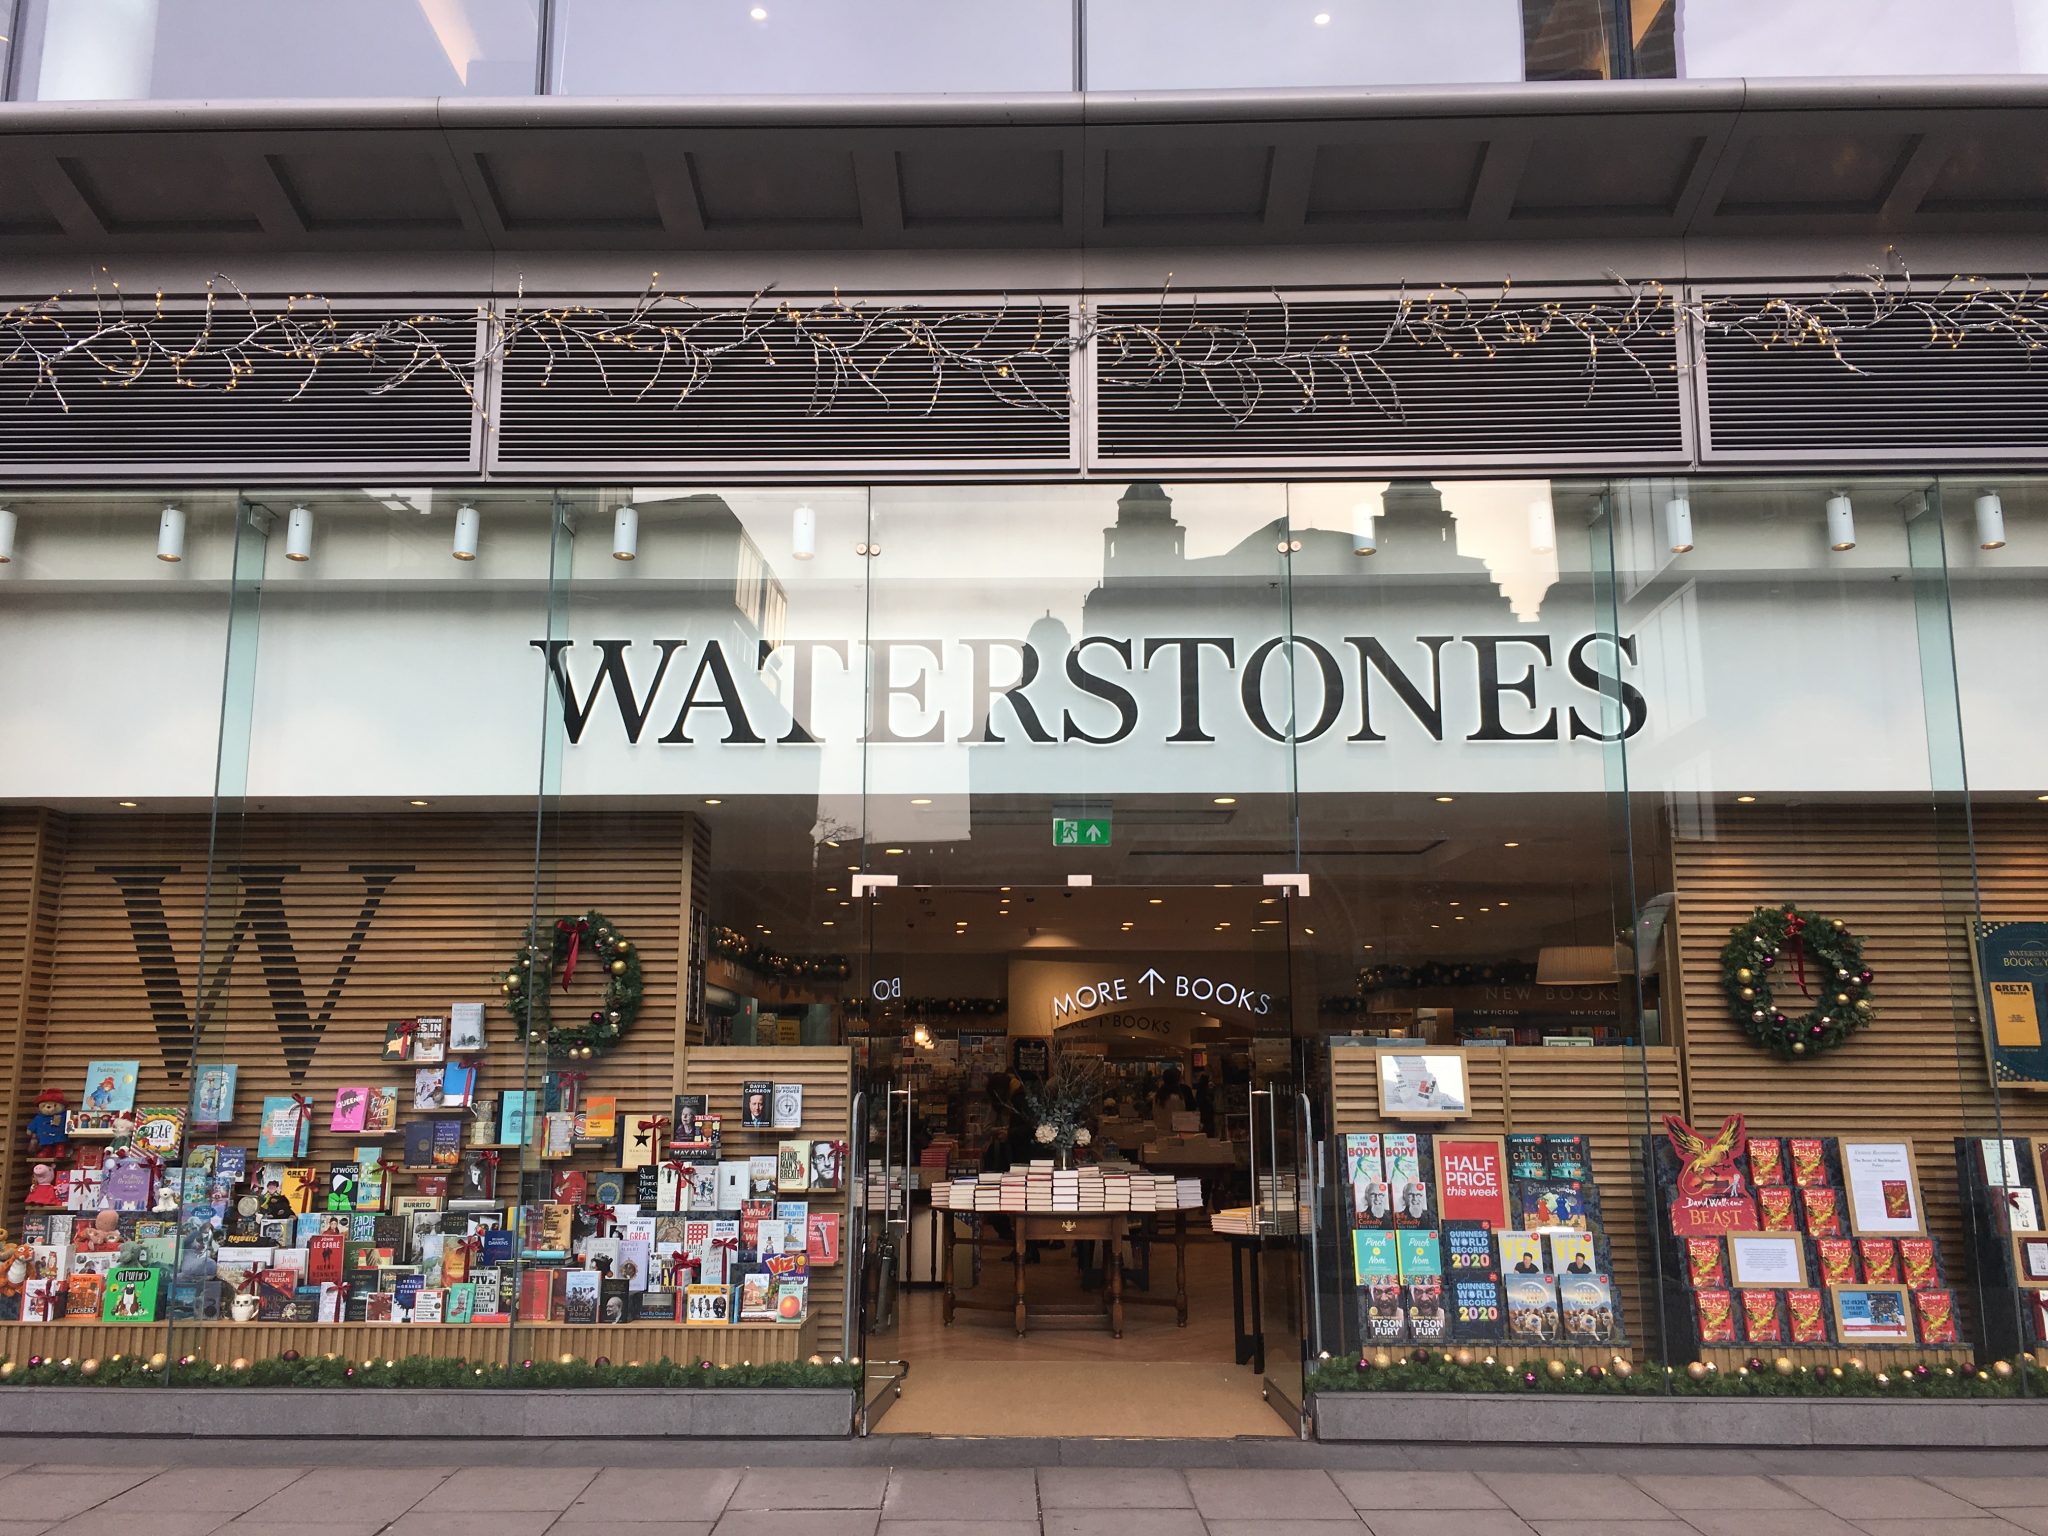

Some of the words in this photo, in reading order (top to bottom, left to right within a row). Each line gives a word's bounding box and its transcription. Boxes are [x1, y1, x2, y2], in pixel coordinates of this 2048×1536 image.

[530, 633, 1648, 745] WATERSTONES
[2004, 958, 2033, 966] BOOK
[1054, 978, 1128, 1017] MORE
[1175, 975, 1271, 1015] BOOKS
[336, 1094, 365, 1109] QUEENIE
[780, 1152, 798, 1161] BLIND
[1348, 1147, 1378, 1157] BODY
[1385, 1147, 1415, 1157] BODY
[1513, 1152, 1543, 1160] CHILD
[1551, 1152, 1581, 1160] CHILD
[1750, 1147, 1778, 1157] BEAST
[1793, 1147, 1821, 1157] BEAST
[780, 1161, 799, 1170] MAN'S
[1444, 1156, 1494, 1171] HALF
[780, 1170, 800, 1178] BREXIT
[1445, 1172, 1496, 1187] PRICE
[1446, 1186, 1467, 1196] this
[1469, 1186, 1498, 1197] week
[1682, 1197, 1709, 1208] David
[1709, 1197, 1743, 1208] Walliams
[1762, 1196, 1790, 1205] BEAST
[1805, 1196, 1833, 1206] BEAST
[747, 1208, 765, 1216] Who
[354, 1215, 375, 1227] ZADIE
[1689, 1210, 1742, 1228] BEAST
[630, 1232, 650, 1240] GREAT
[1365, 1238, 1386, 1246] Pinch
[1408, 1238, 1430, 1246] Pinch
[1450, 1238, 1488, 1246] WORLD
[1502, 1239, 1539, 1260] VEG
[1554, 1239, 1591, 1260] VEG
[1690, 1247, 1717, 1257] BEAST
[765, 1255, 795, 1275] VIZ
[1452, 1254, 1490, 1267] 2020
[470, 1275, 496, 1284] FIVE
[1457, 1290, 1496, 1299] WORLD
[1700, 1299, 1728, 1308] BEAST
[1459, 1307, 1497, 1321] 2020
